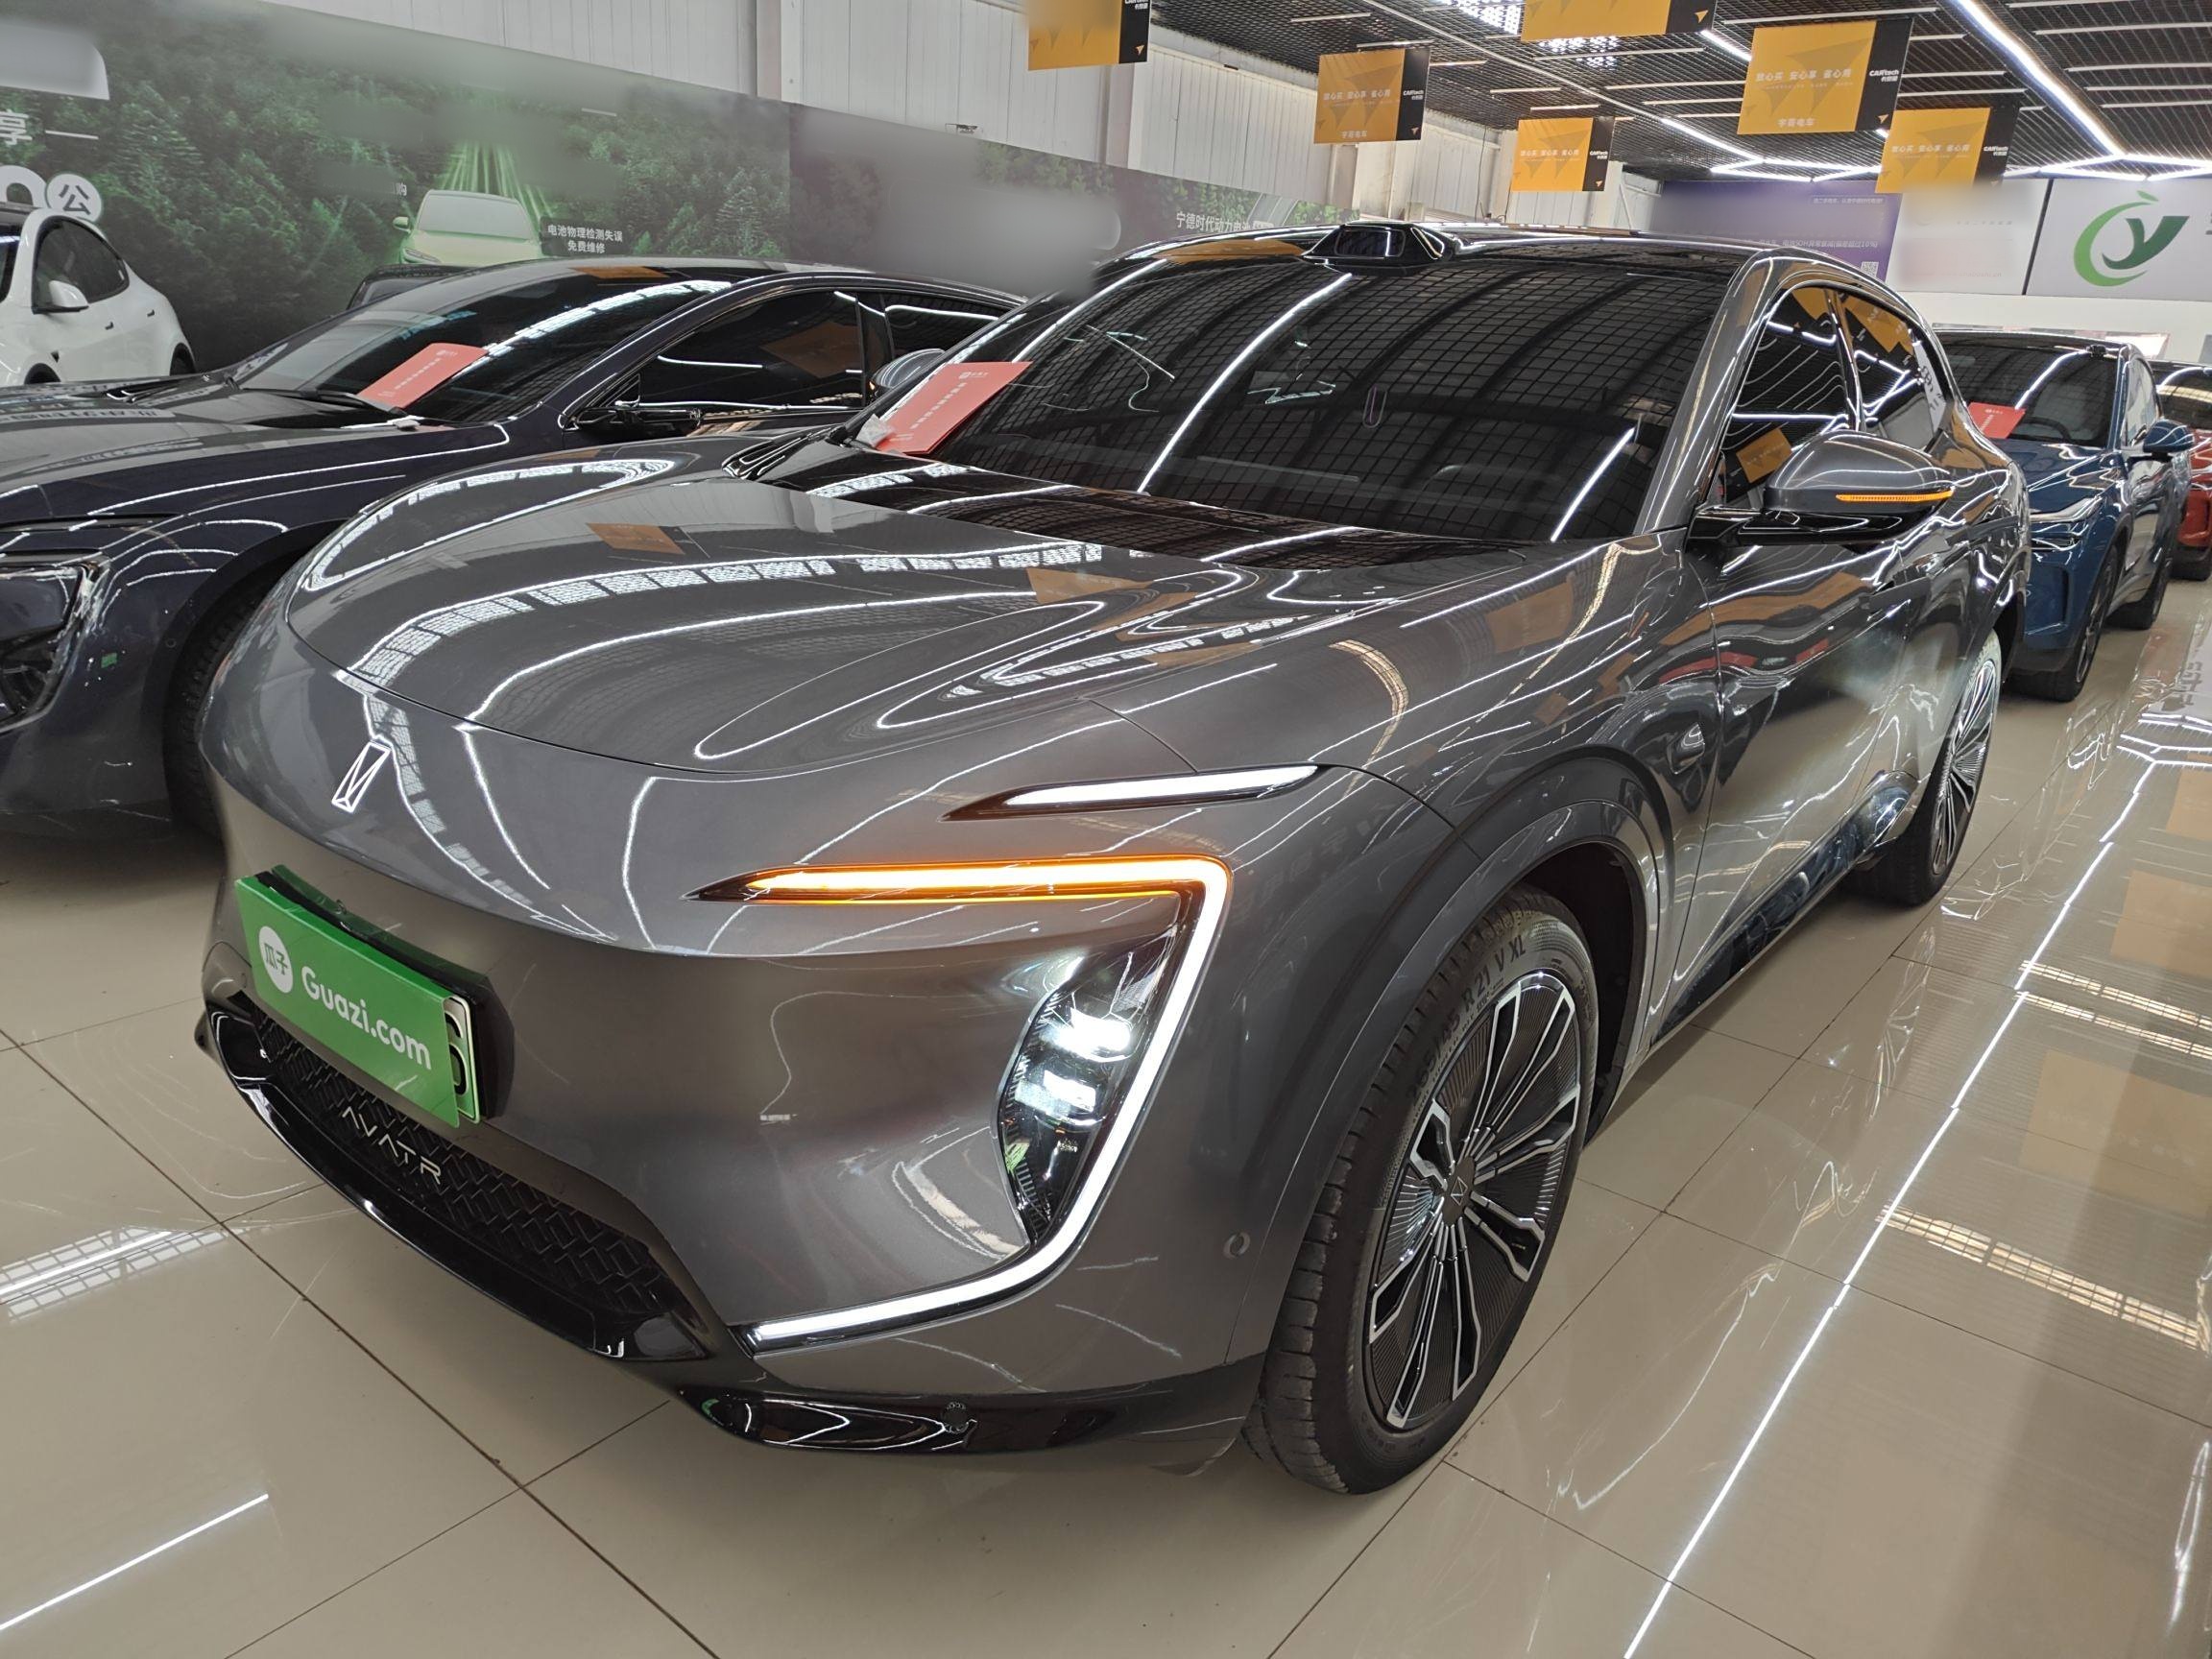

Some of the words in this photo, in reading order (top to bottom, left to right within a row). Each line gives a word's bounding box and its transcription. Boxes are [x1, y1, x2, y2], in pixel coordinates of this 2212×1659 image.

[547, 224, 623, 243] 电池物理检测失误
[567, 240, 606, 254] 免费维修
[264, 943, 289, 976] 瓜子
[1508, 934, 1527, 964] XL
[301, 966, 432, 1070] Guazi.com
